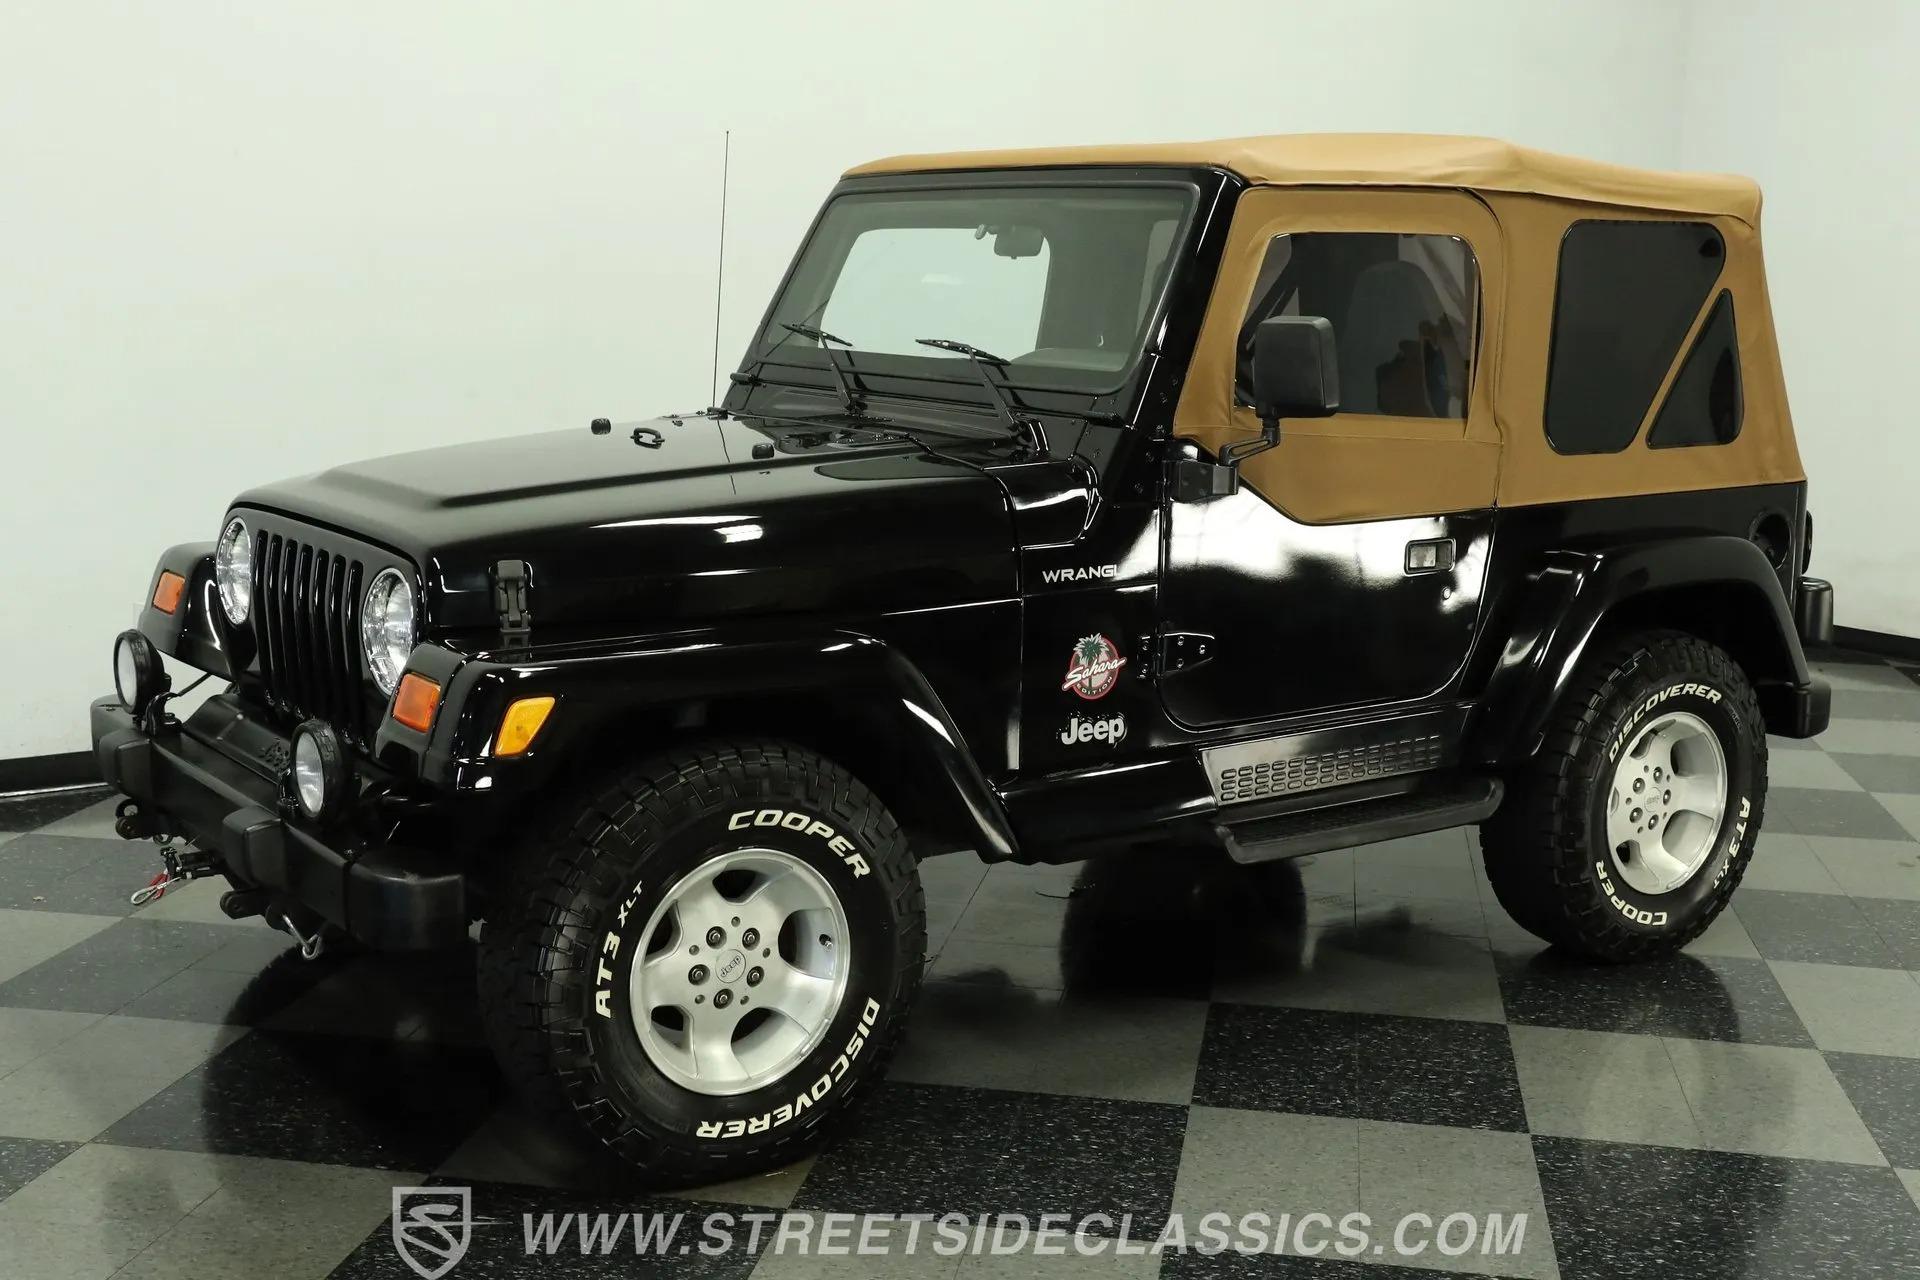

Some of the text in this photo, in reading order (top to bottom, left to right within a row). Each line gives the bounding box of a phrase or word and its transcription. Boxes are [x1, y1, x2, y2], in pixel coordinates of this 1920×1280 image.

[1042, 564, 1121, 583] WRANGL
[1063, 658, 1126, 689] Sahara
[1077, 676, 1113, 695] EDITION
[1061, 717, 1125, 745] Jeep
[1608, 683, 1722, 763] DISCOVERER
[728, 809, 871, 879] COOPER
[1713, 796, 1751, 890] AT3 XLT
[1595, 860, 1668, 926] COOPER
[595, 880, 642, 1019] AT3 XLT
[696, 997, 881, 1139] DISCOVERER
